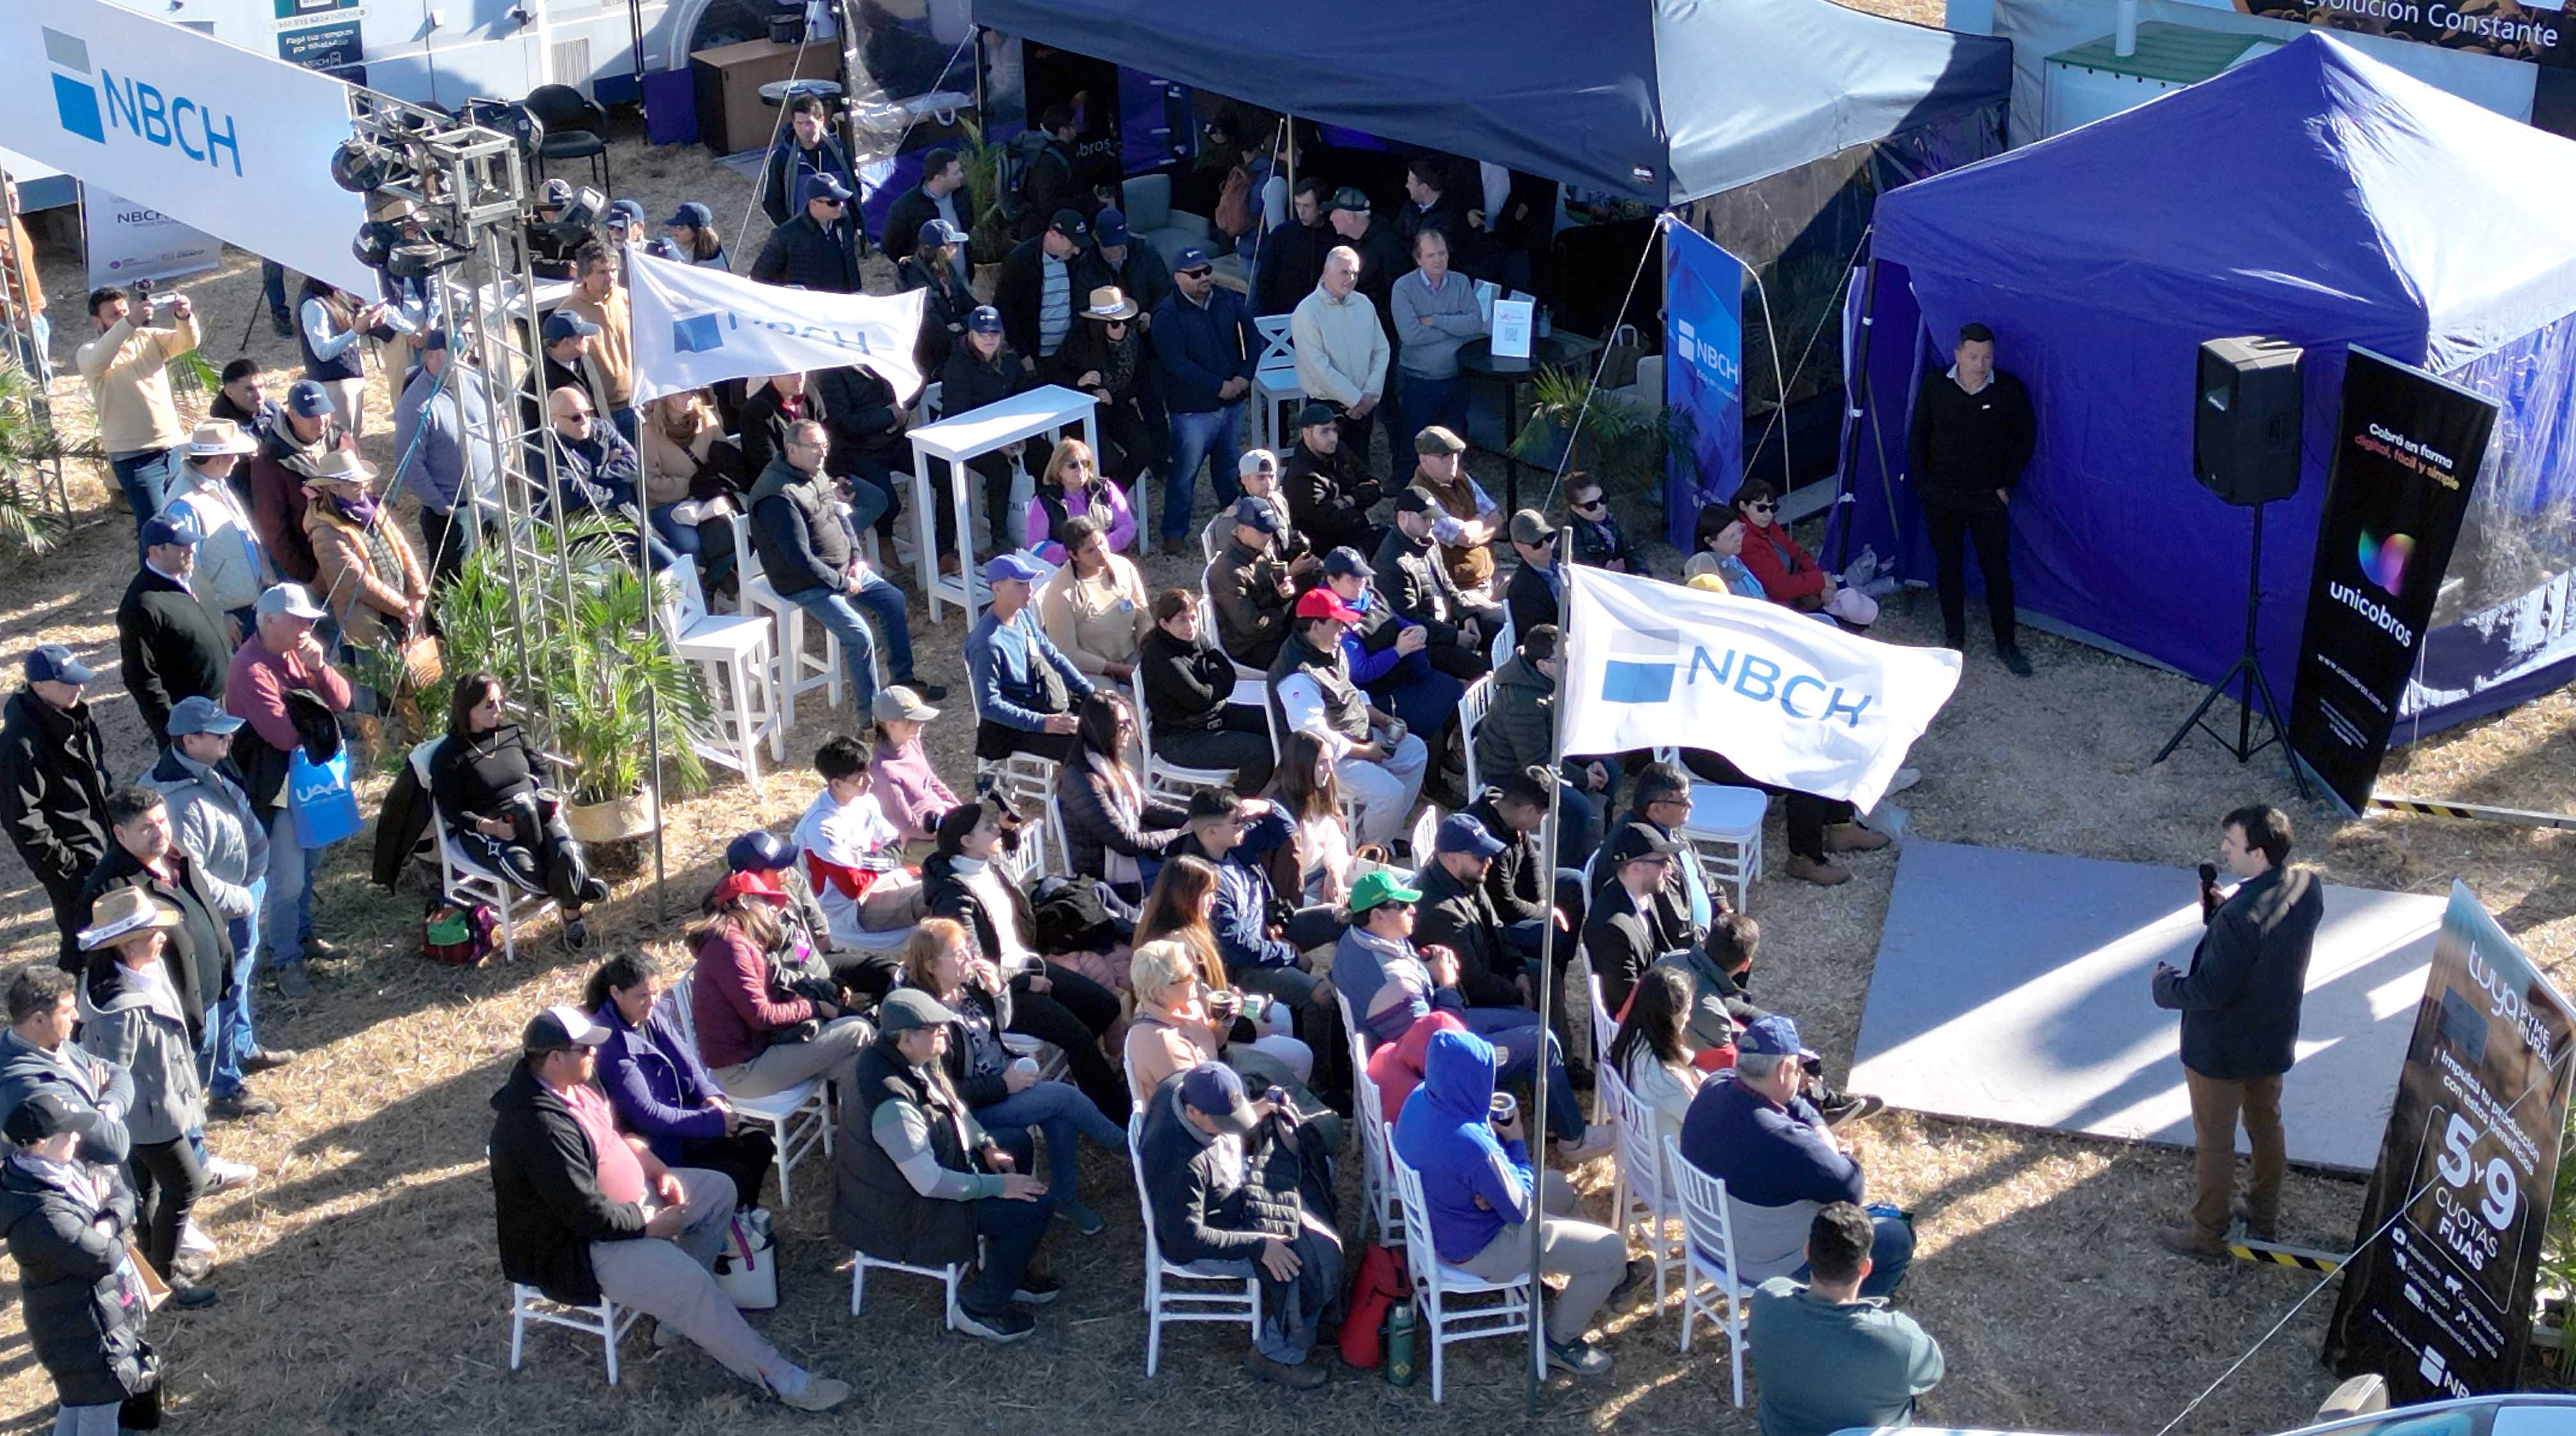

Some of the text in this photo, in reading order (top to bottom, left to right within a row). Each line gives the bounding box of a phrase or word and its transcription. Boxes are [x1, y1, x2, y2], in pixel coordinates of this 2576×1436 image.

[2304, 0, 2557, 47] oución Constante
[102, 68, 243, 178] NBCH
[1697, 338, 1738, 384] NBCH
[2369, 423, 2453, 469] Cobrá en forma
[2426, 466, 2460, 491] simple
[2330, 581, 2412, 647] unicobros
[1687, 645, 1872, 728] NBCH
[2469, 941, 2518, 1021] tuya
[2518, 1020, 2554, 1072] RURAL
[2520, 1002, 2550, 1045] PYME
[2444, 1075, 2534, 1176] con estos beneficios
[2481, 1088, 2492, 1106] tu
[2491, 1102, 2540, 1163] producción
[2437, 1113, 2478, 1188] 5
[2481, 1157, 2517, 1230] 9
[2435, 1187, 2498, 1258] CUOTAS
[2438, 1216, 2484, 1271] FIJAS
